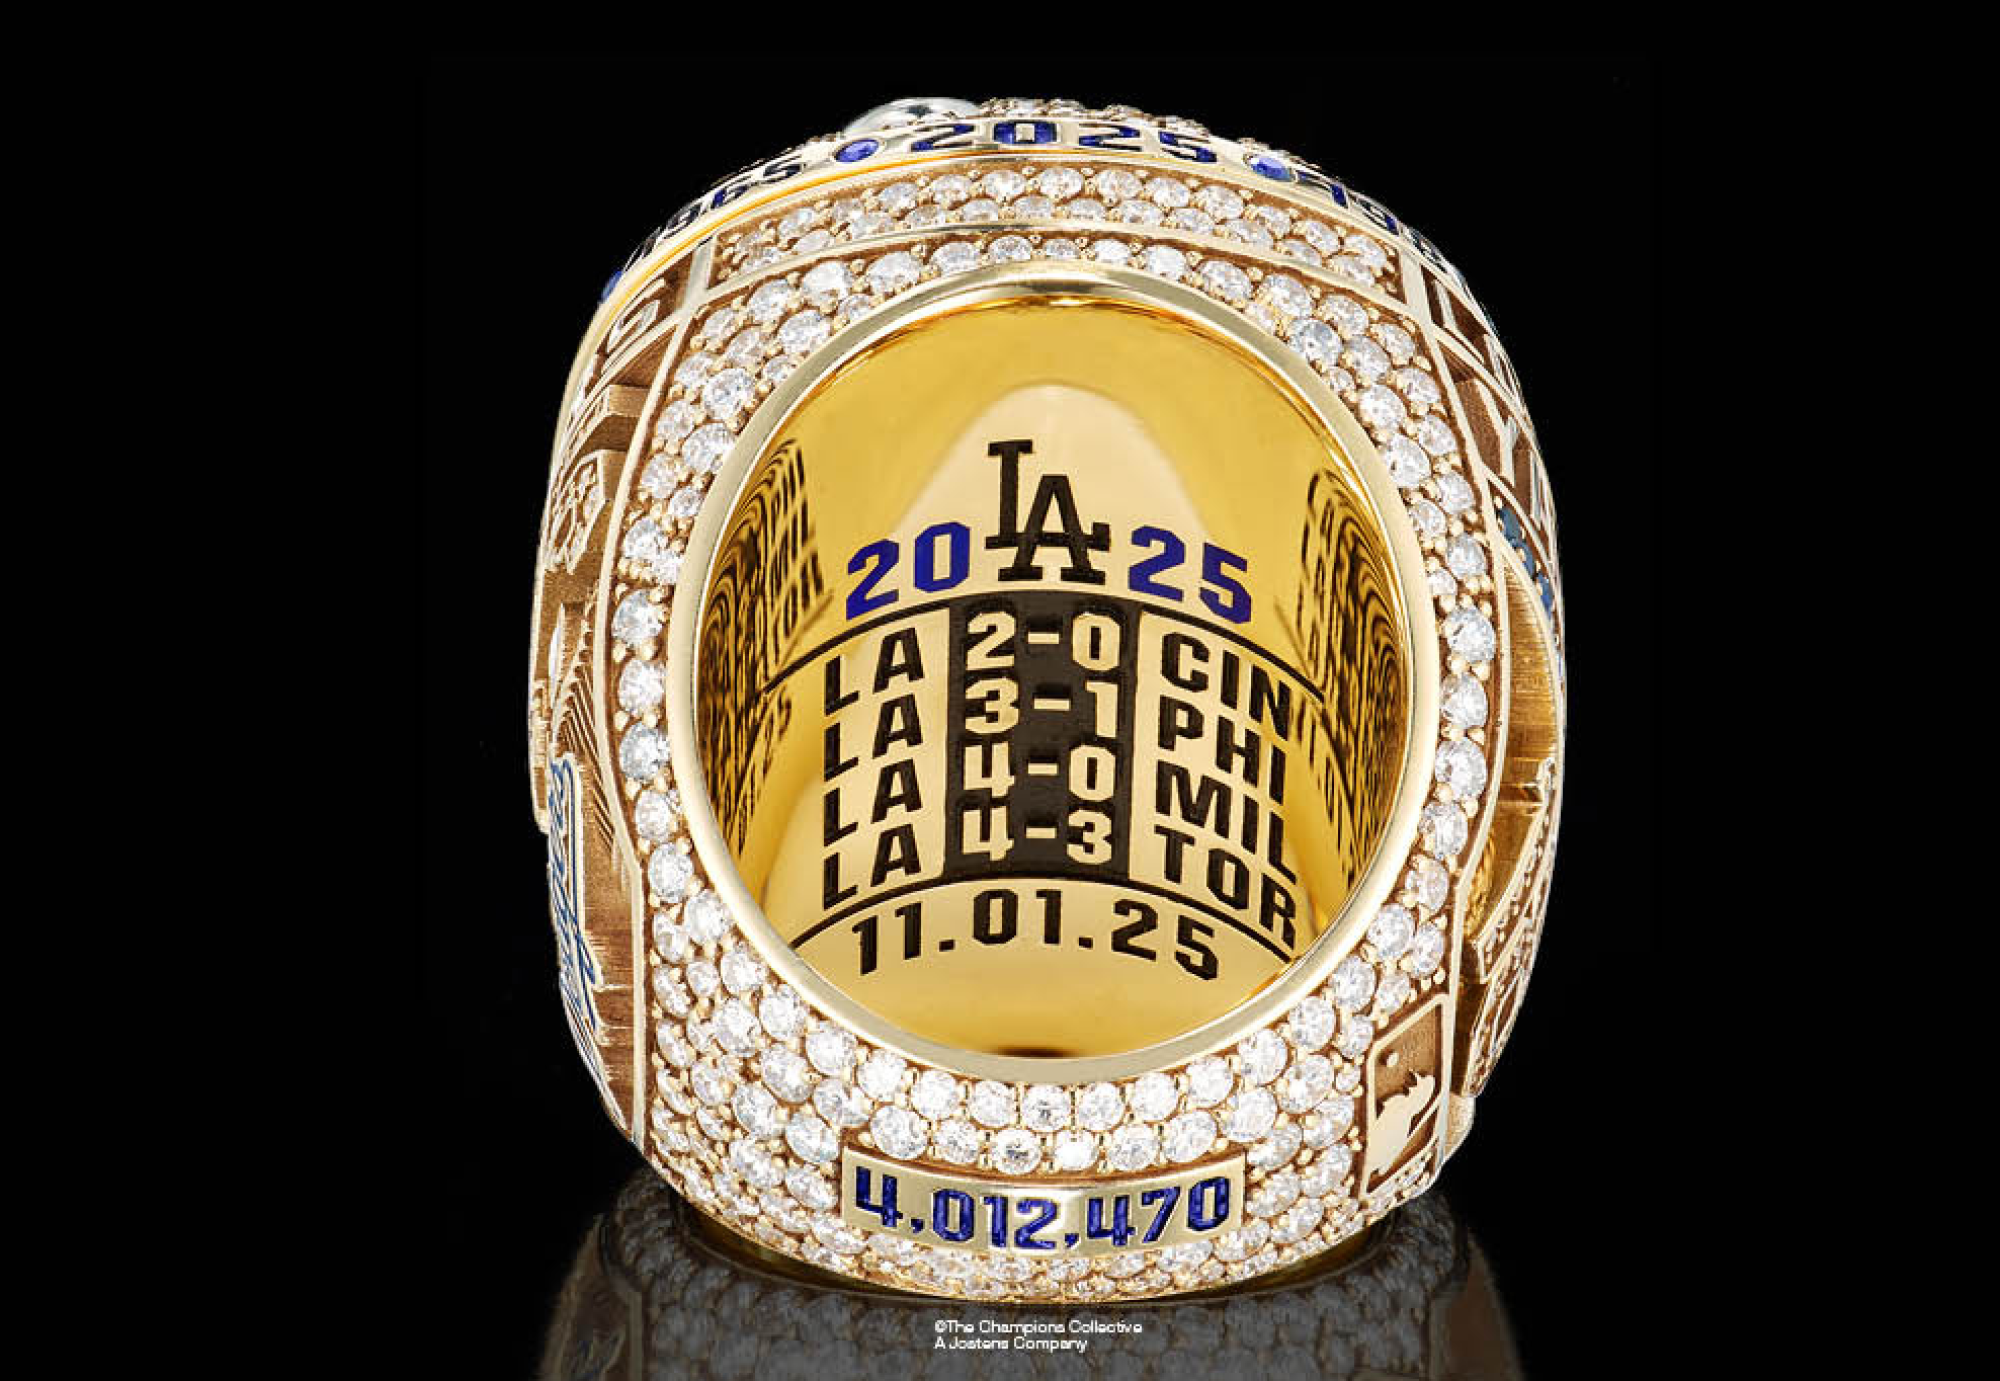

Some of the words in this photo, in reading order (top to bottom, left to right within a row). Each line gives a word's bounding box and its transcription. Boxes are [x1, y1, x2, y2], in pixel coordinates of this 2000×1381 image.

[911, 119, 1217, 163] 2025
[846, 521, 970, 621] 20
[1129, 525, 1251, 624] 25
[985, 439, 1111, 586] LA
[826, 627, 924, 716] LA
[966, 610, 1121, 672] 2-0
[1161, 632, 1291, 741] CIN
[825, 692, 923, 782] LA
[965, 677, 1118, 738] 3-1
[1158, 695, 1286, 805] PHI
[823, 758, 922, 847] LA
[963, 744, 1115, 801] 4-0
[1156, 760, 1296, 886] MIL
[823, 824, 922, 910] LA
[962, 806, 1112, 865] 4-3
[1155, 825, 1297, 951] TOR
[851, 888, 1218, 981] 11.01.25
[855, 1164, 1231, 1249] 4,012,470
